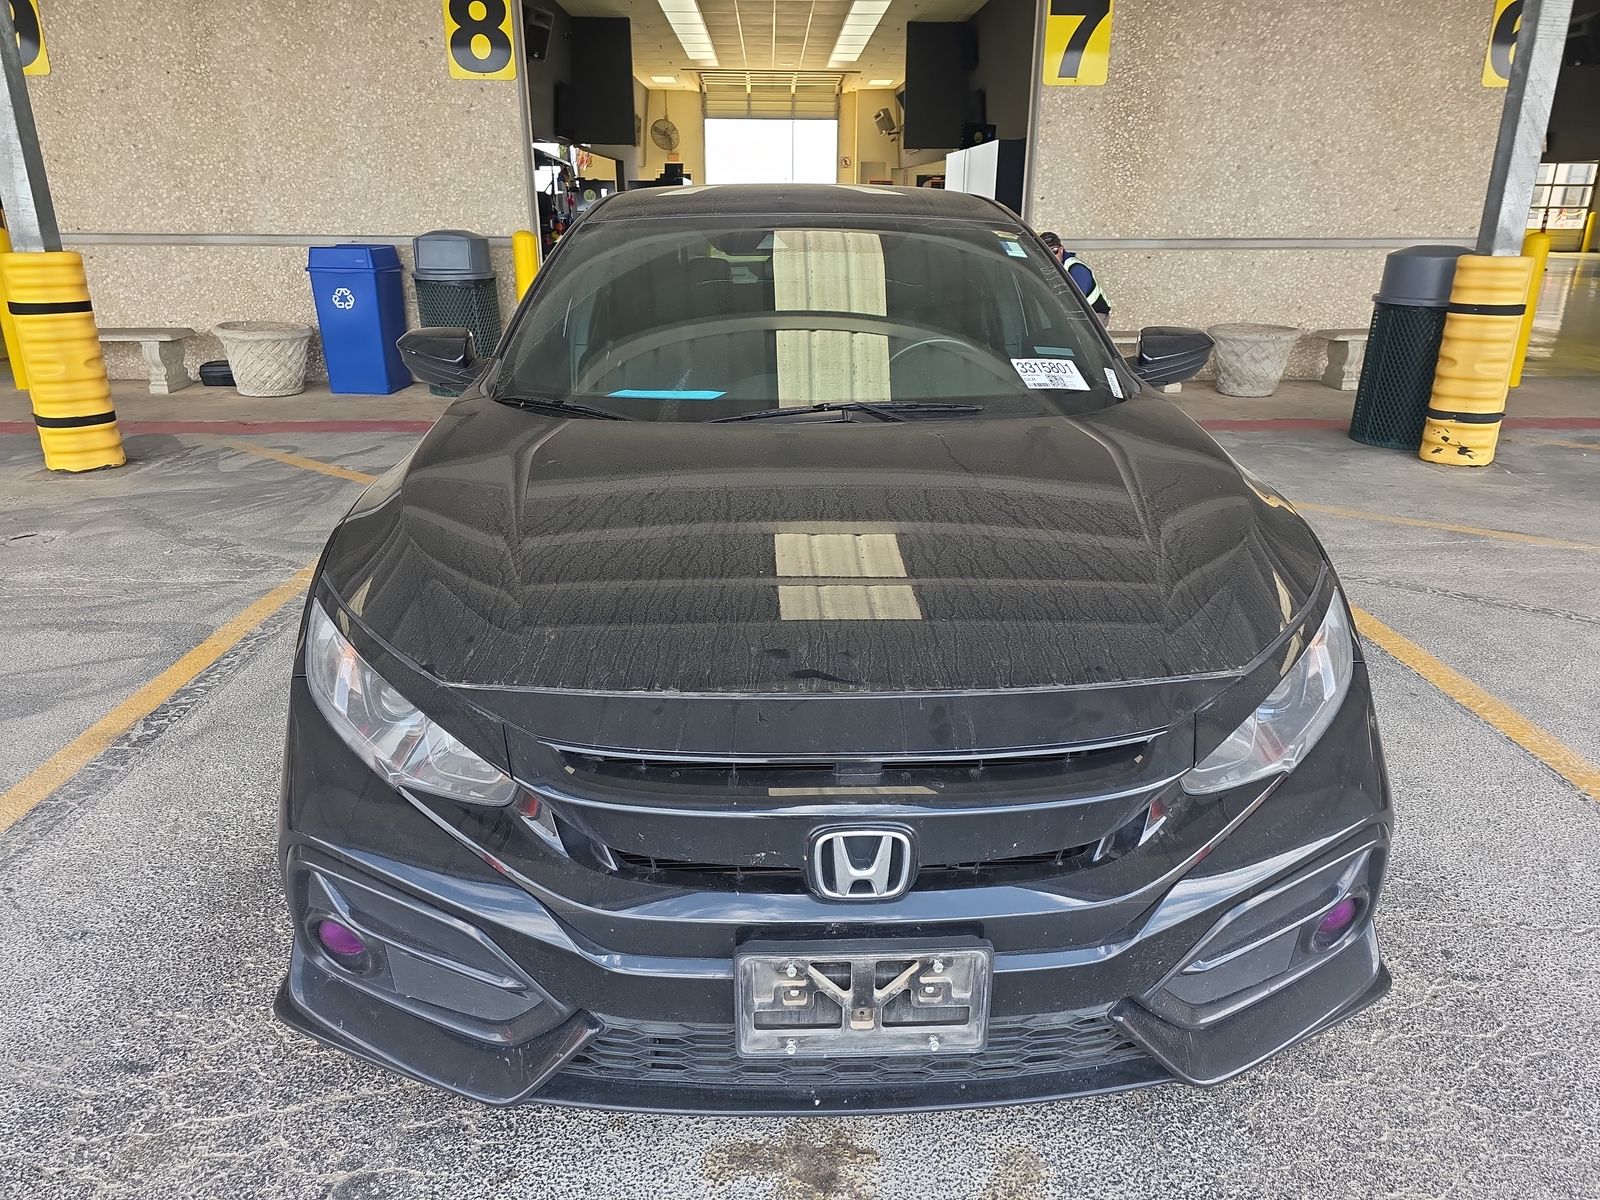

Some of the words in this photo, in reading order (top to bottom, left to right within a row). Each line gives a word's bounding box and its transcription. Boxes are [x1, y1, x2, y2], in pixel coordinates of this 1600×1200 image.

[449, 0, 511, 73] 8
[1050, 0, 1110, 78] 7
[1016, 361, 1073, 374] 3315801
